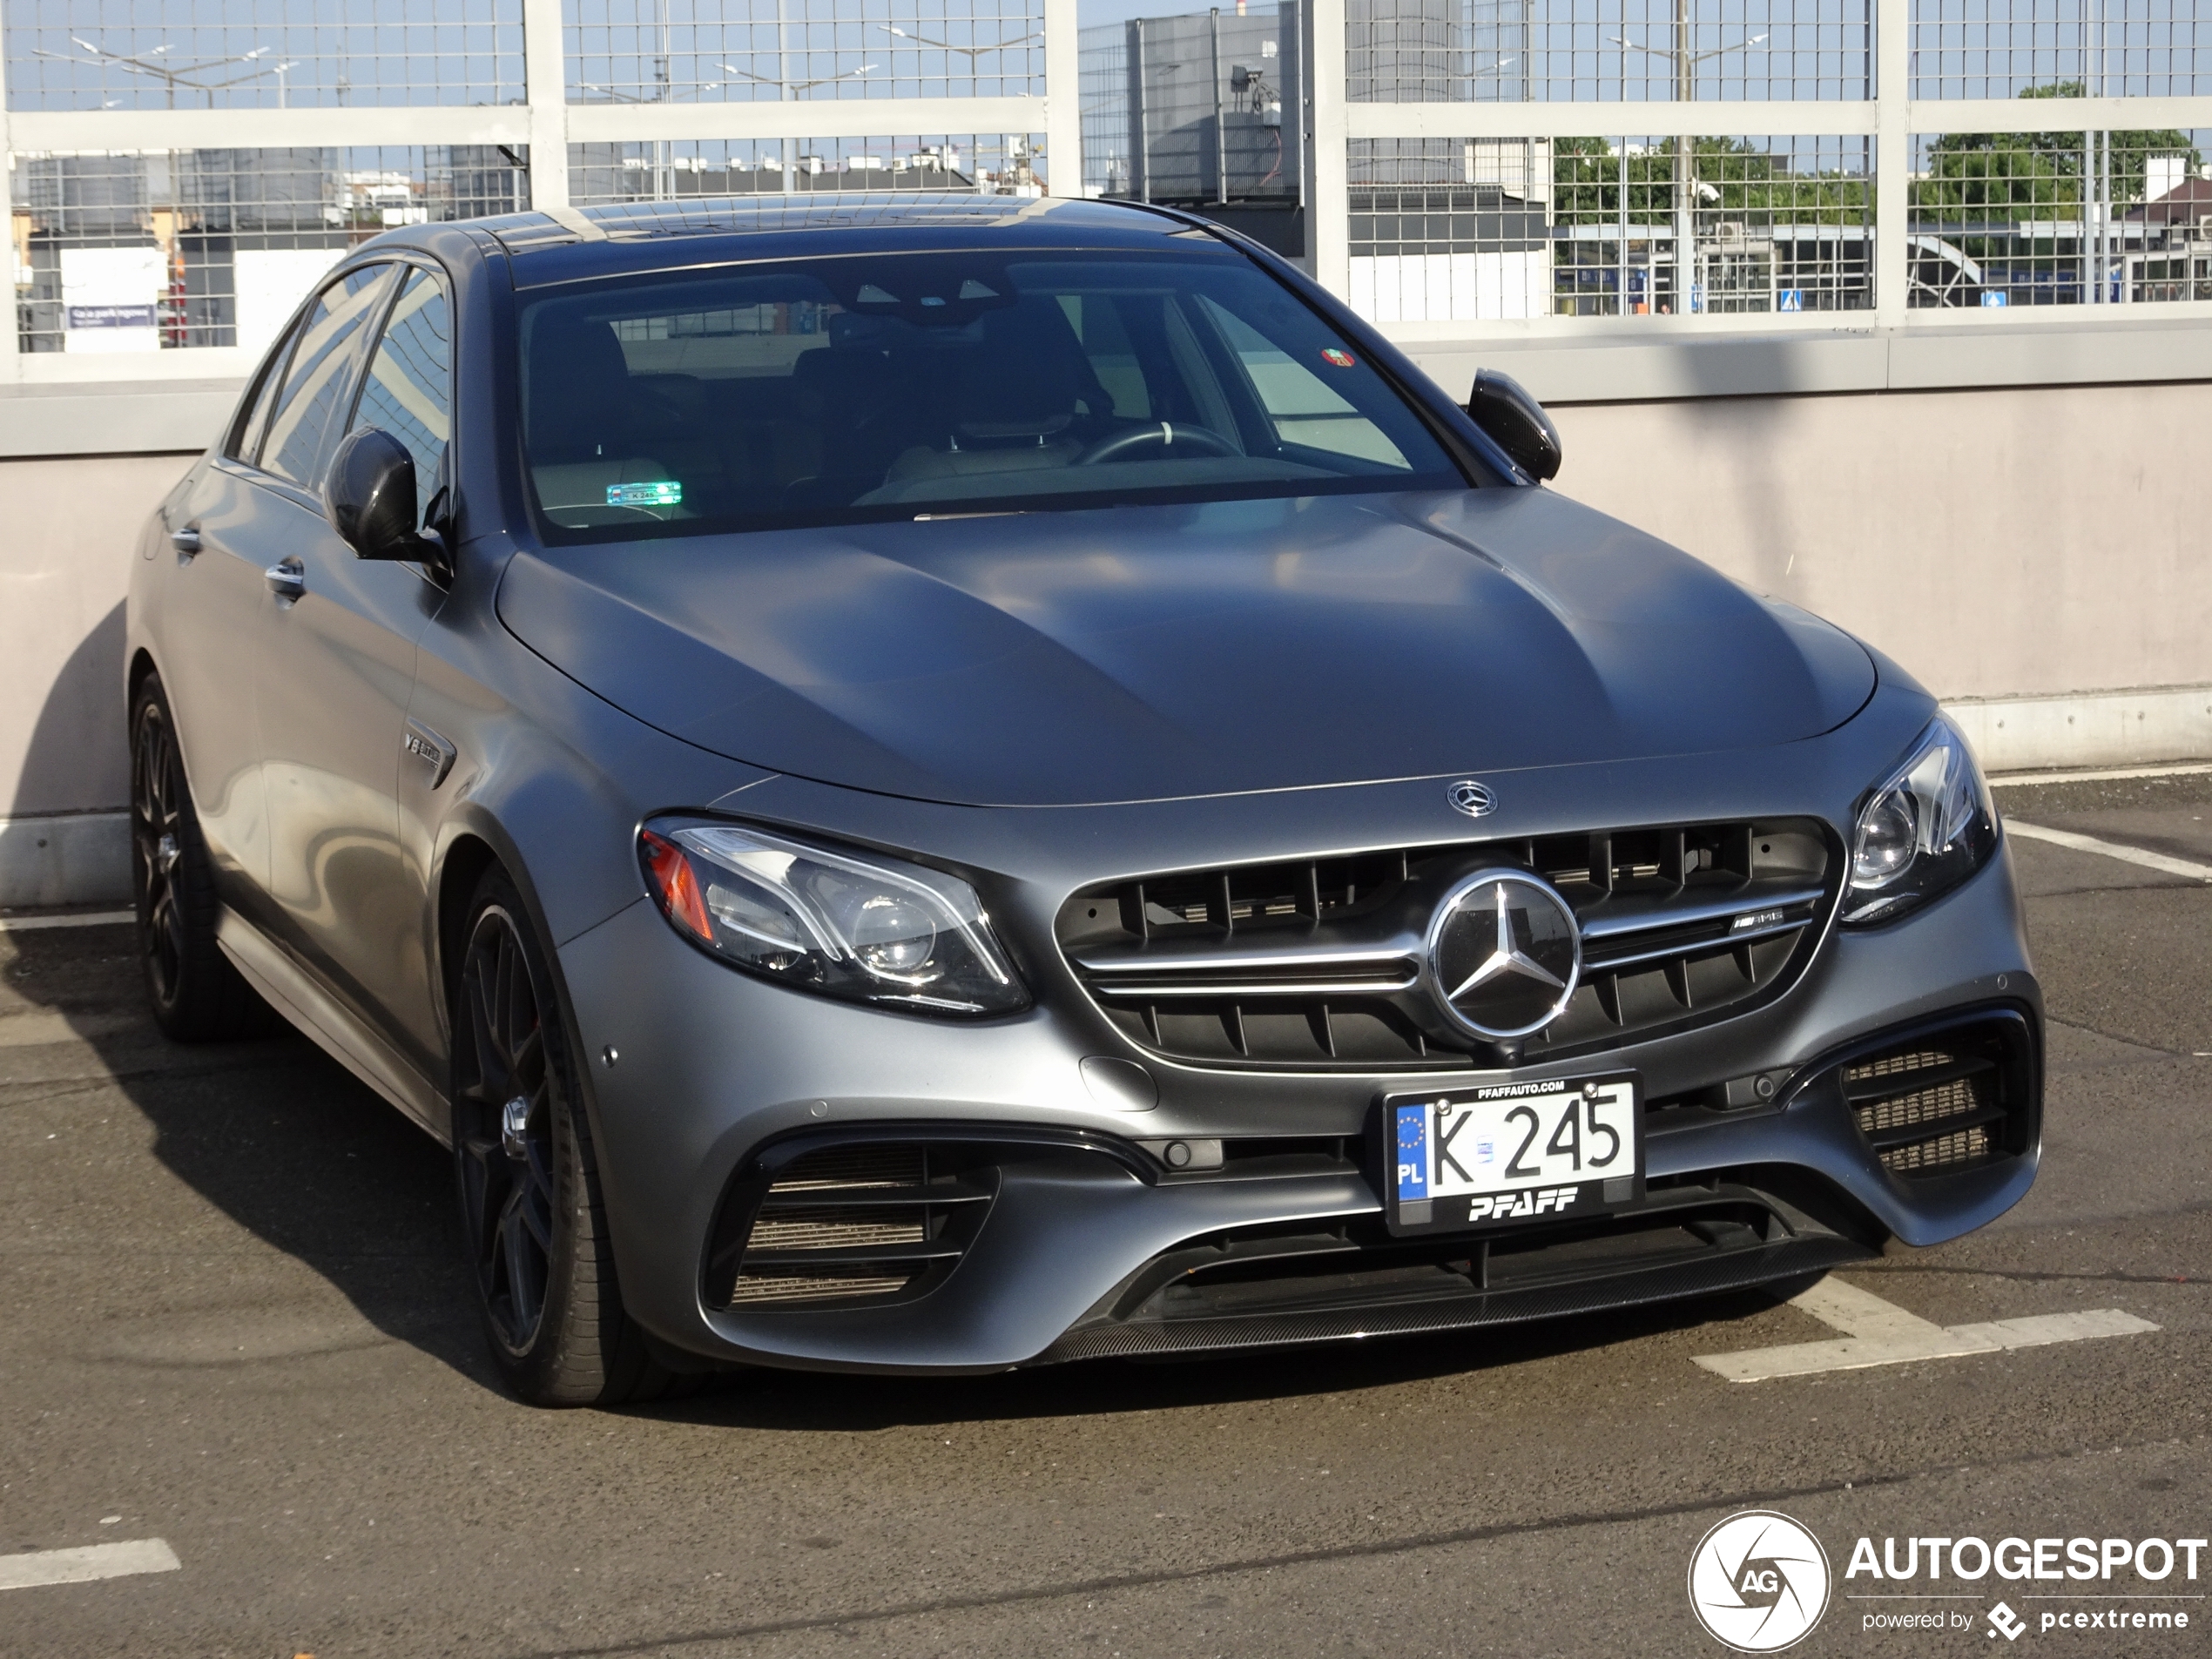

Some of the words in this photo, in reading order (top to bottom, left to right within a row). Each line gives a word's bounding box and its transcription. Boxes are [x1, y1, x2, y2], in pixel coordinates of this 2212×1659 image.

[404, 733, 421, 754] V8
[1478, 1081, 1565, 1099] PFAFFAUTO.COM
[1433, 1110, 1474, 1185] K
[1503, 1094, 1621, 1179] 245
[1398, 1164, 1423, 1185] PL
[1468, 1186, 1578, 1222] PFAFF
